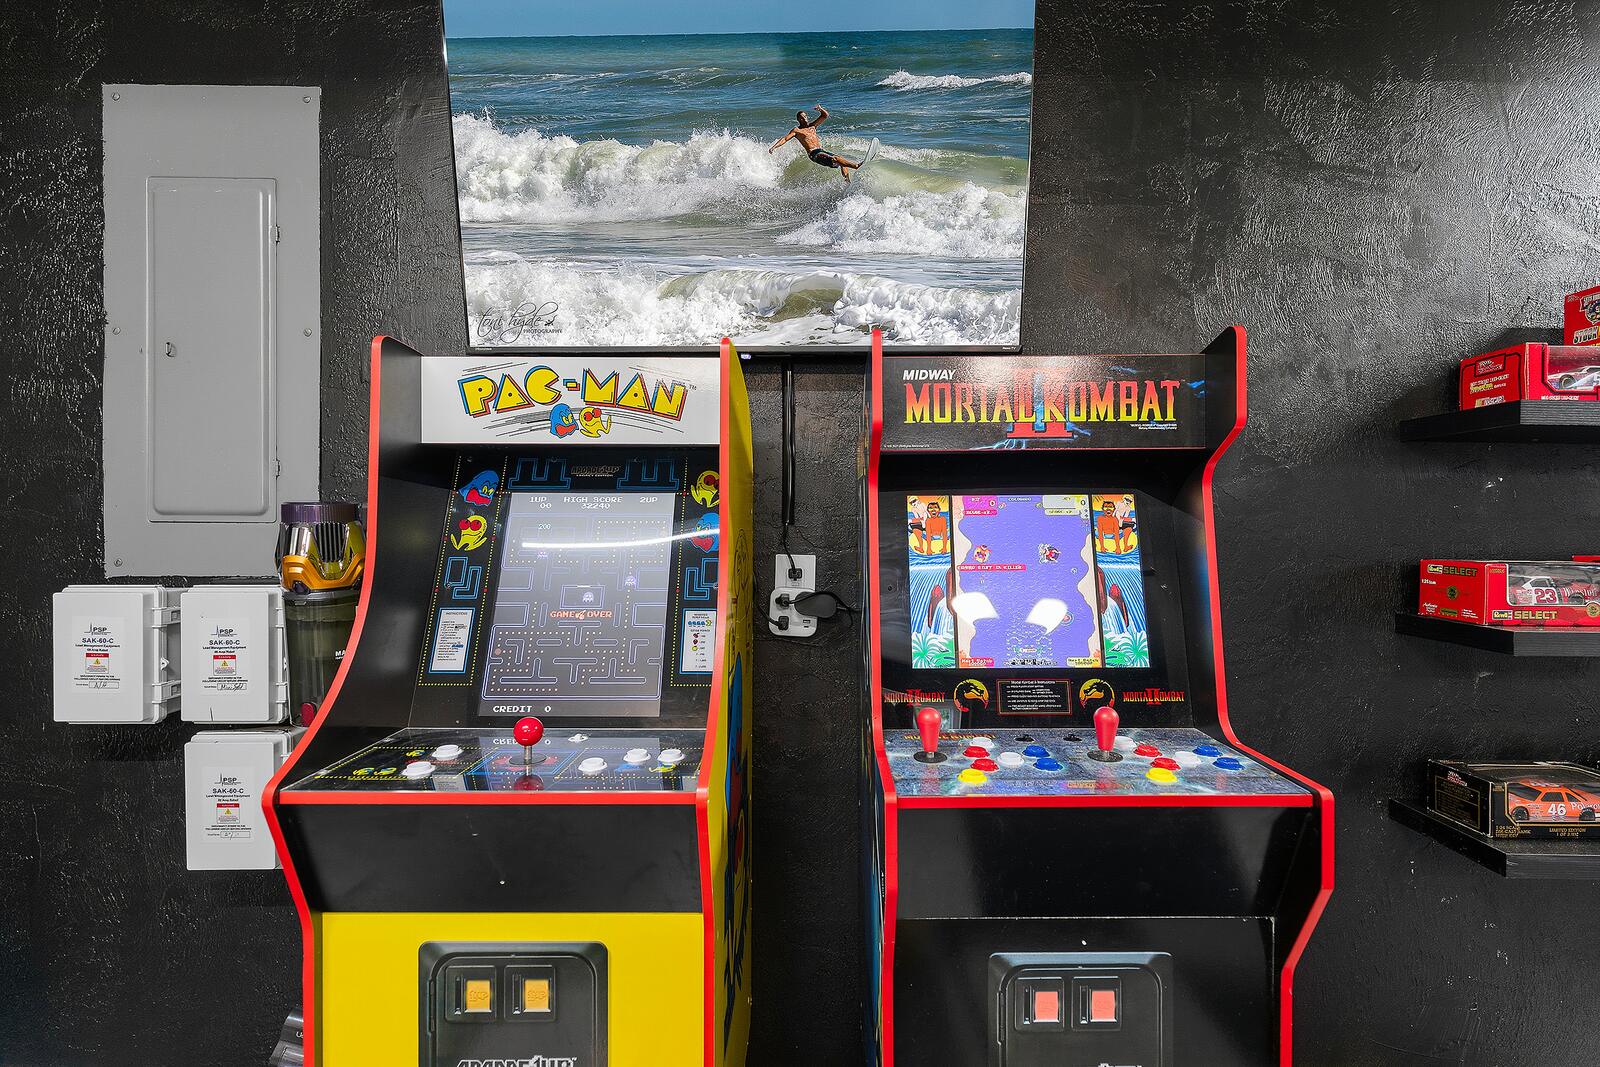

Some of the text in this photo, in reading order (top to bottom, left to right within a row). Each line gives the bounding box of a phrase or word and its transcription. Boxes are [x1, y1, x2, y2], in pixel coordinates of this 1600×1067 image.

[477, 302, 558, 343] toni hyde
[902, 369, 956, 381] MIDWAY
[458, 365, 689, 422] PAC-MAN
[904, 382, 1036, 424] MORTAL
[1042, 380, 1180, 422] KOMBAT
[1443, 566, 1478, 577] SELECT
[1534, 588, 1557, 603] 23
[550, 610, 612, 618] GAME OVER
[1514, 611, 1558, 620] SELECT
[884, 691, 914, 703] MORTAL
[914, 690, 945, 703] KOMBAT
[1122, 691, 1153, 703] MORTAL
[1153, 690, 1185, 702] KOMBAT
[492, 705, 552, 713] CREDIT 0
[1547, 803, 1567, 816] 46
